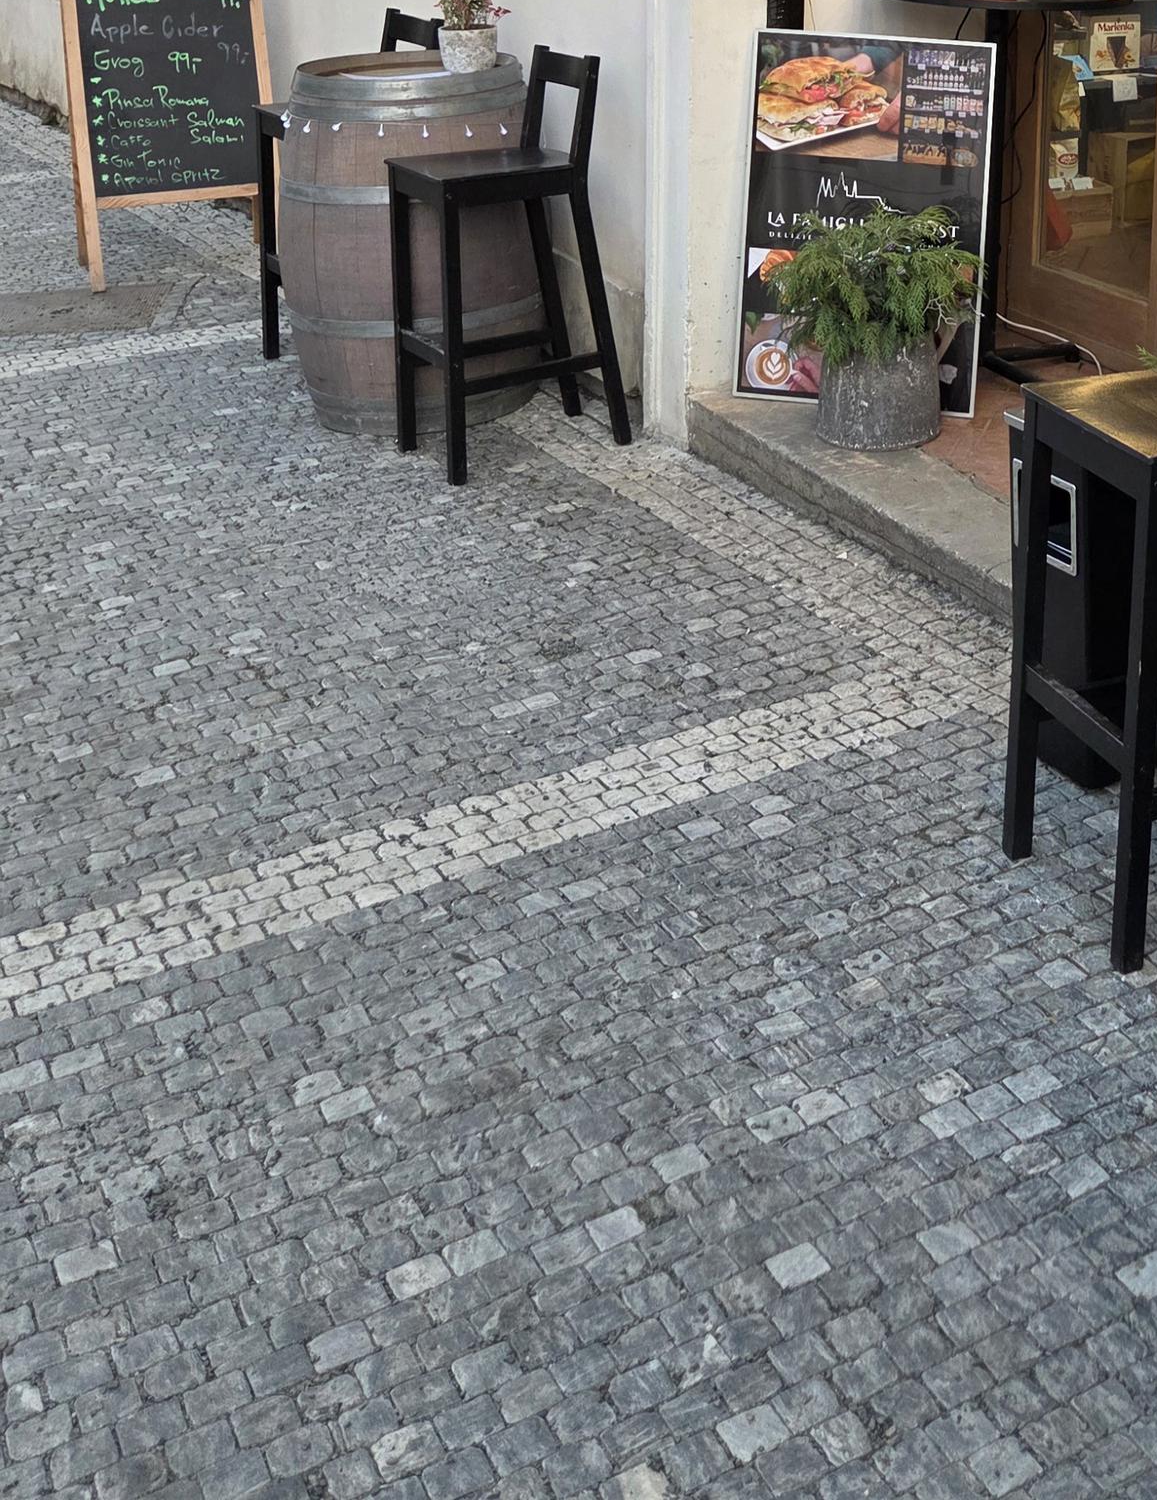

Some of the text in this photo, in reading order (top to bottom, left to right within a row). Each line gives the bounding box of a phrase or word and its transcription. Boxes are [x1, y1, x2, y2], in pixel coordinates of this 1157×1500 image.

[90, 12, 224, 44] Apple Cider
[1098, 21, 1135, 32] Marlenka
[93, 49, 145, 78] Grog
[102, 85, 209, 110] Pinsa Romana
[107, 111, 179, 130] Croissant
[111, 155, 135, 168] Gin
[767, 211, 786, 227] LA
